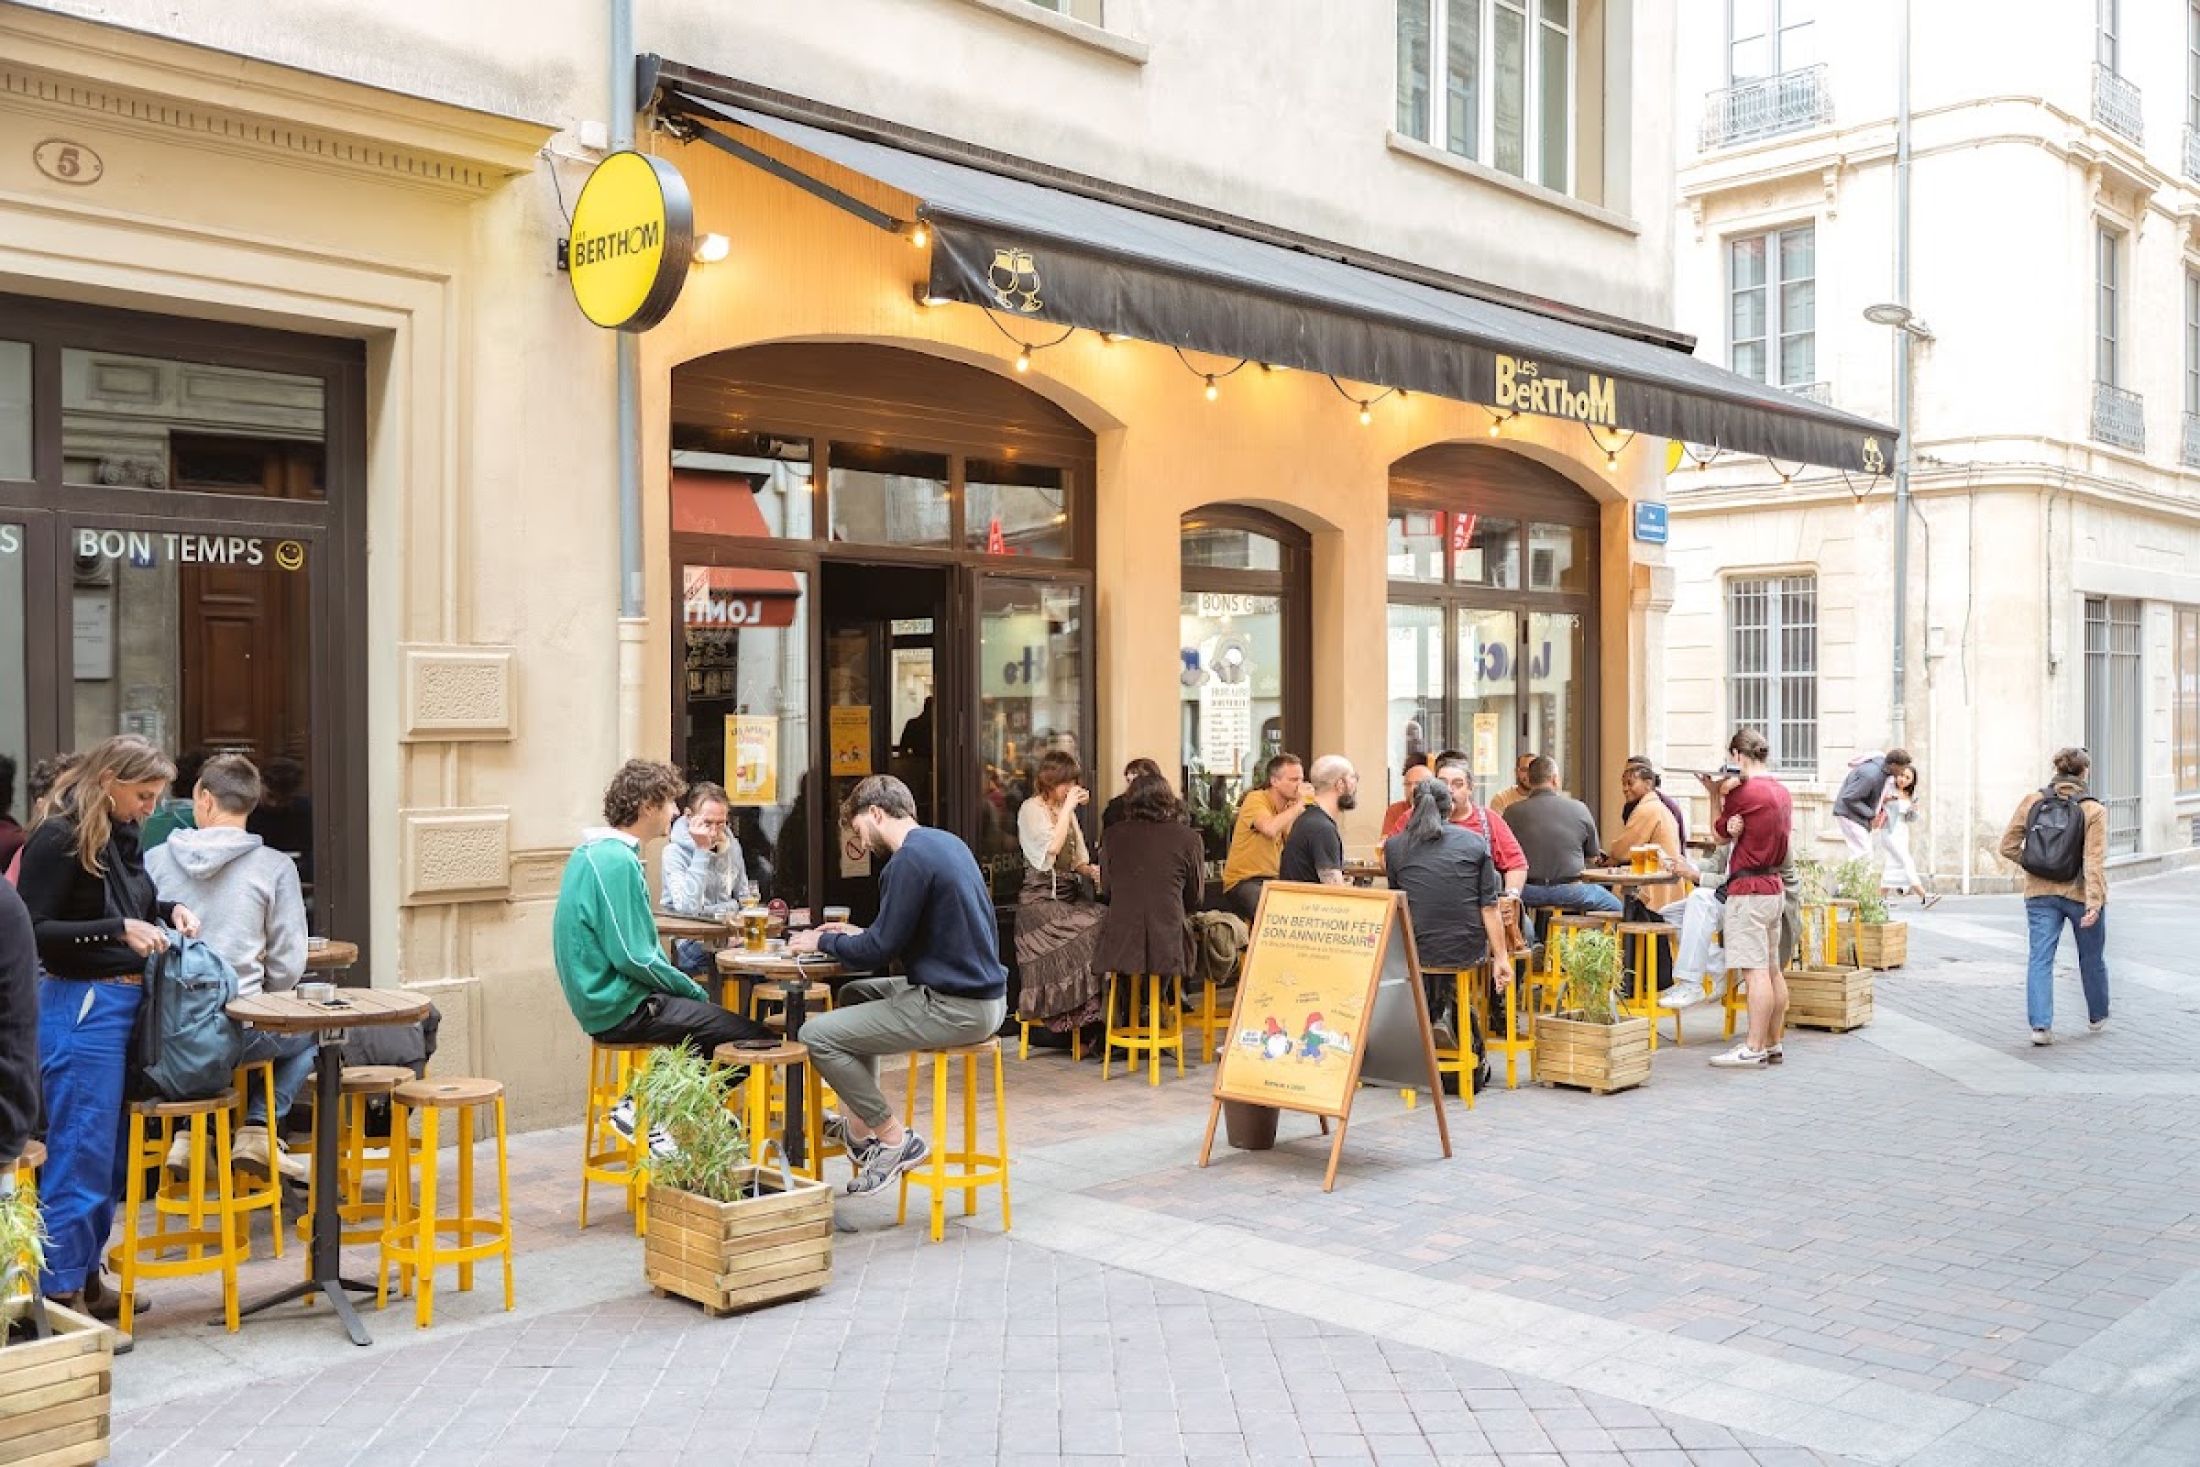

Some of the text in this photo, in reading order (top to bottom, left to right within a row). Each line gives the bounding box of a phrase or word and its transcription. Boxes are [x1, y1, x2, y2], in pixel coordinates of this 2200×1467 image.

[57, 147, 80, 177] 5
[574, 220, 659, 268] BERTHOM
[79, 528, 265, 566] BON TEMPS
[1202, 592, 1239, 612] BONS
[1262, 927, 1288, 939] SON
[1266, 914, 1383, 934] TON BERTHOM FÊTE
